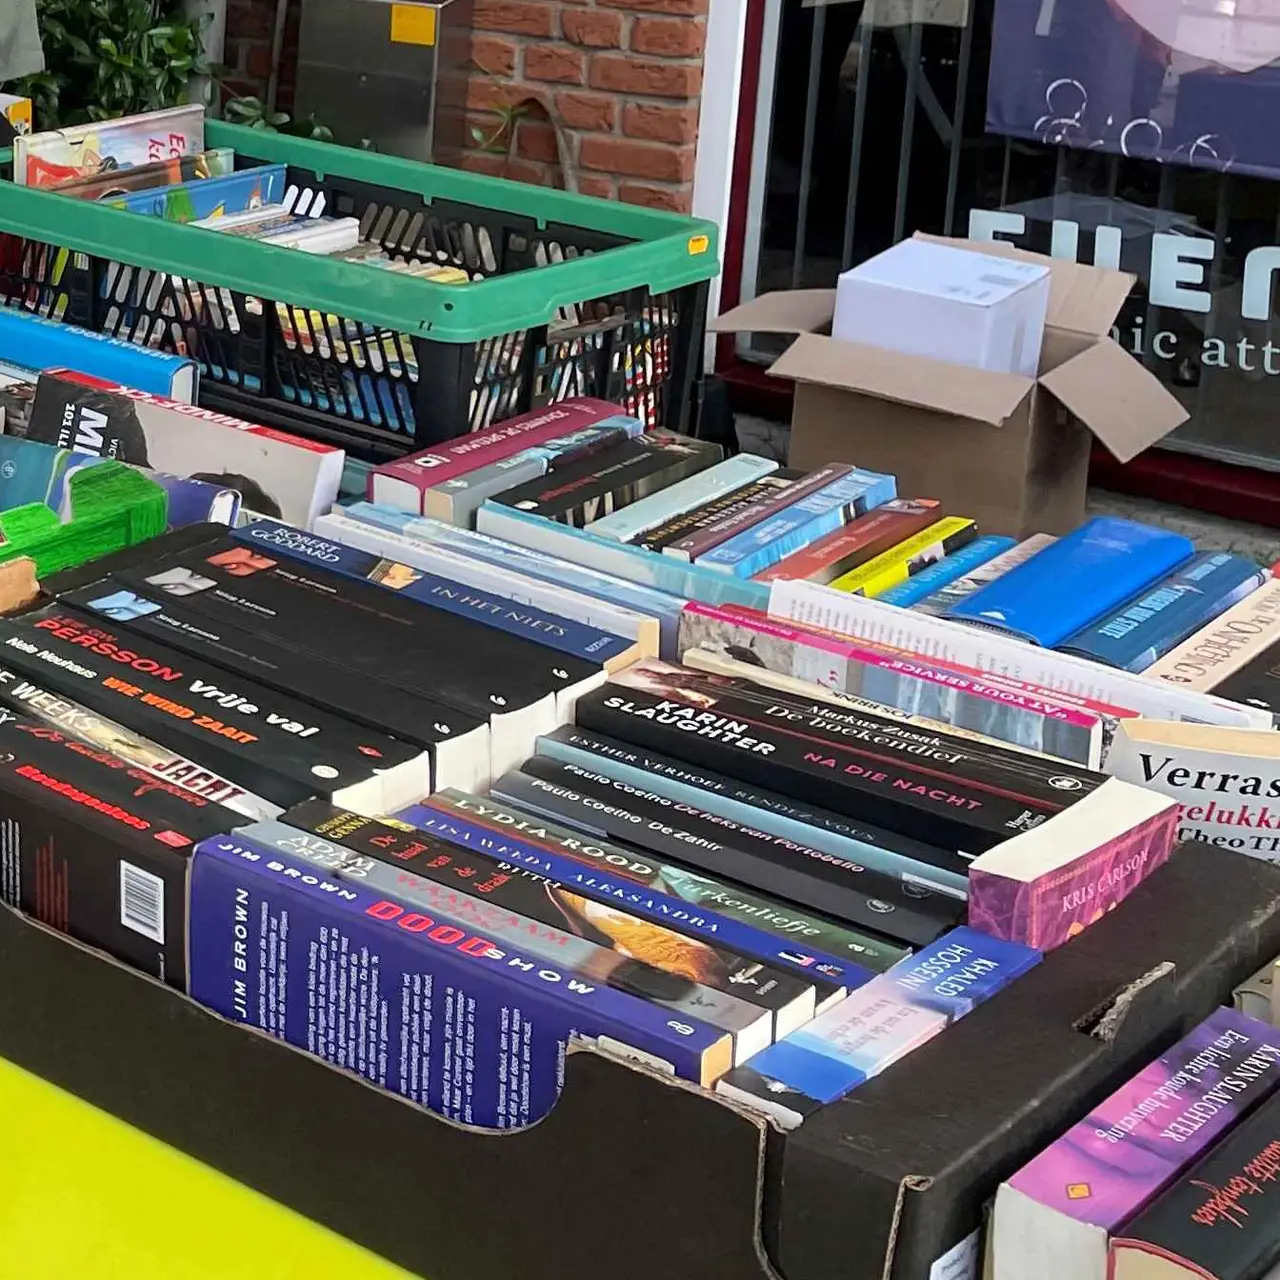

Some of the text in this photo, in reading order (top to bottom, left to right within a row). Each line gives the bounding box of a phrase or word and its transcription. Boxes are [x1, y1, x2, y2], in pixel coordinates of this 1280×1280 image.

[60, 404, 75, 426] 101
[251, 529, 340, 563] GODDARD
[274, 527, 341, 552] ROBERT
[430, 585, 571, 638] IN HET NIETS
[34, 619, 320, 739] PERSSON Vrije val
[37, 650, 98, 680] Neuhaus
[102, 676, 143, 698] WIE
[141, 691, 195, 720] WIND
[192, 715, 260, 745] ZAAIT
[966, 680, 1028, 710] YOUR
[10, 681, 94, 732] WEEKS
[653, 700, 749, 733] KARIN
[805, 703, 943, 750] Markus Zusak
[828, 689, 913, 723] JOS BRINK
[603, 697, 984, 813] SLAUGHTER NA DIE NACHT
[762, 704, 967, 766] De boekendief
[569, 734, 637, 763] ESTHER
[642, 757, 726, 791] VERHOEF
[454, 798, 547, 839] LYDIA
[560, 836, 654, 877] ROOD
[530, 778, 723, 853] Paulo Coelho De Zahir
[563, 762, 867, 874] Paulo Coelho De heks van Portobello
[1178, 827, 1246, 849] Theo
[218, 841, 262, 862] JIM
[266, 860, 358, 902] BROWN
[292, 834, 377, 871] ADAM
[425, 818, 471, 841] LISA
[571, 870, 721, 934] ALEKSANDRA
[1061, 882, 1096, 914] KRIS
[1095, 849, 1151, 895] CARLSON
[233, 887, 249, 1019] JIM BROWN
[896, 943, 973, 993] HOSSEINI
[933, 957, 1000, 999] KHALED
[1197, 1038, 1234, 1075] lichte
[1226, 1028, 1251, 1048] Een
[1159, 1067, 1255, 1144] SLAUGHTER
[1161, 1060, 1204, 1105] koude
